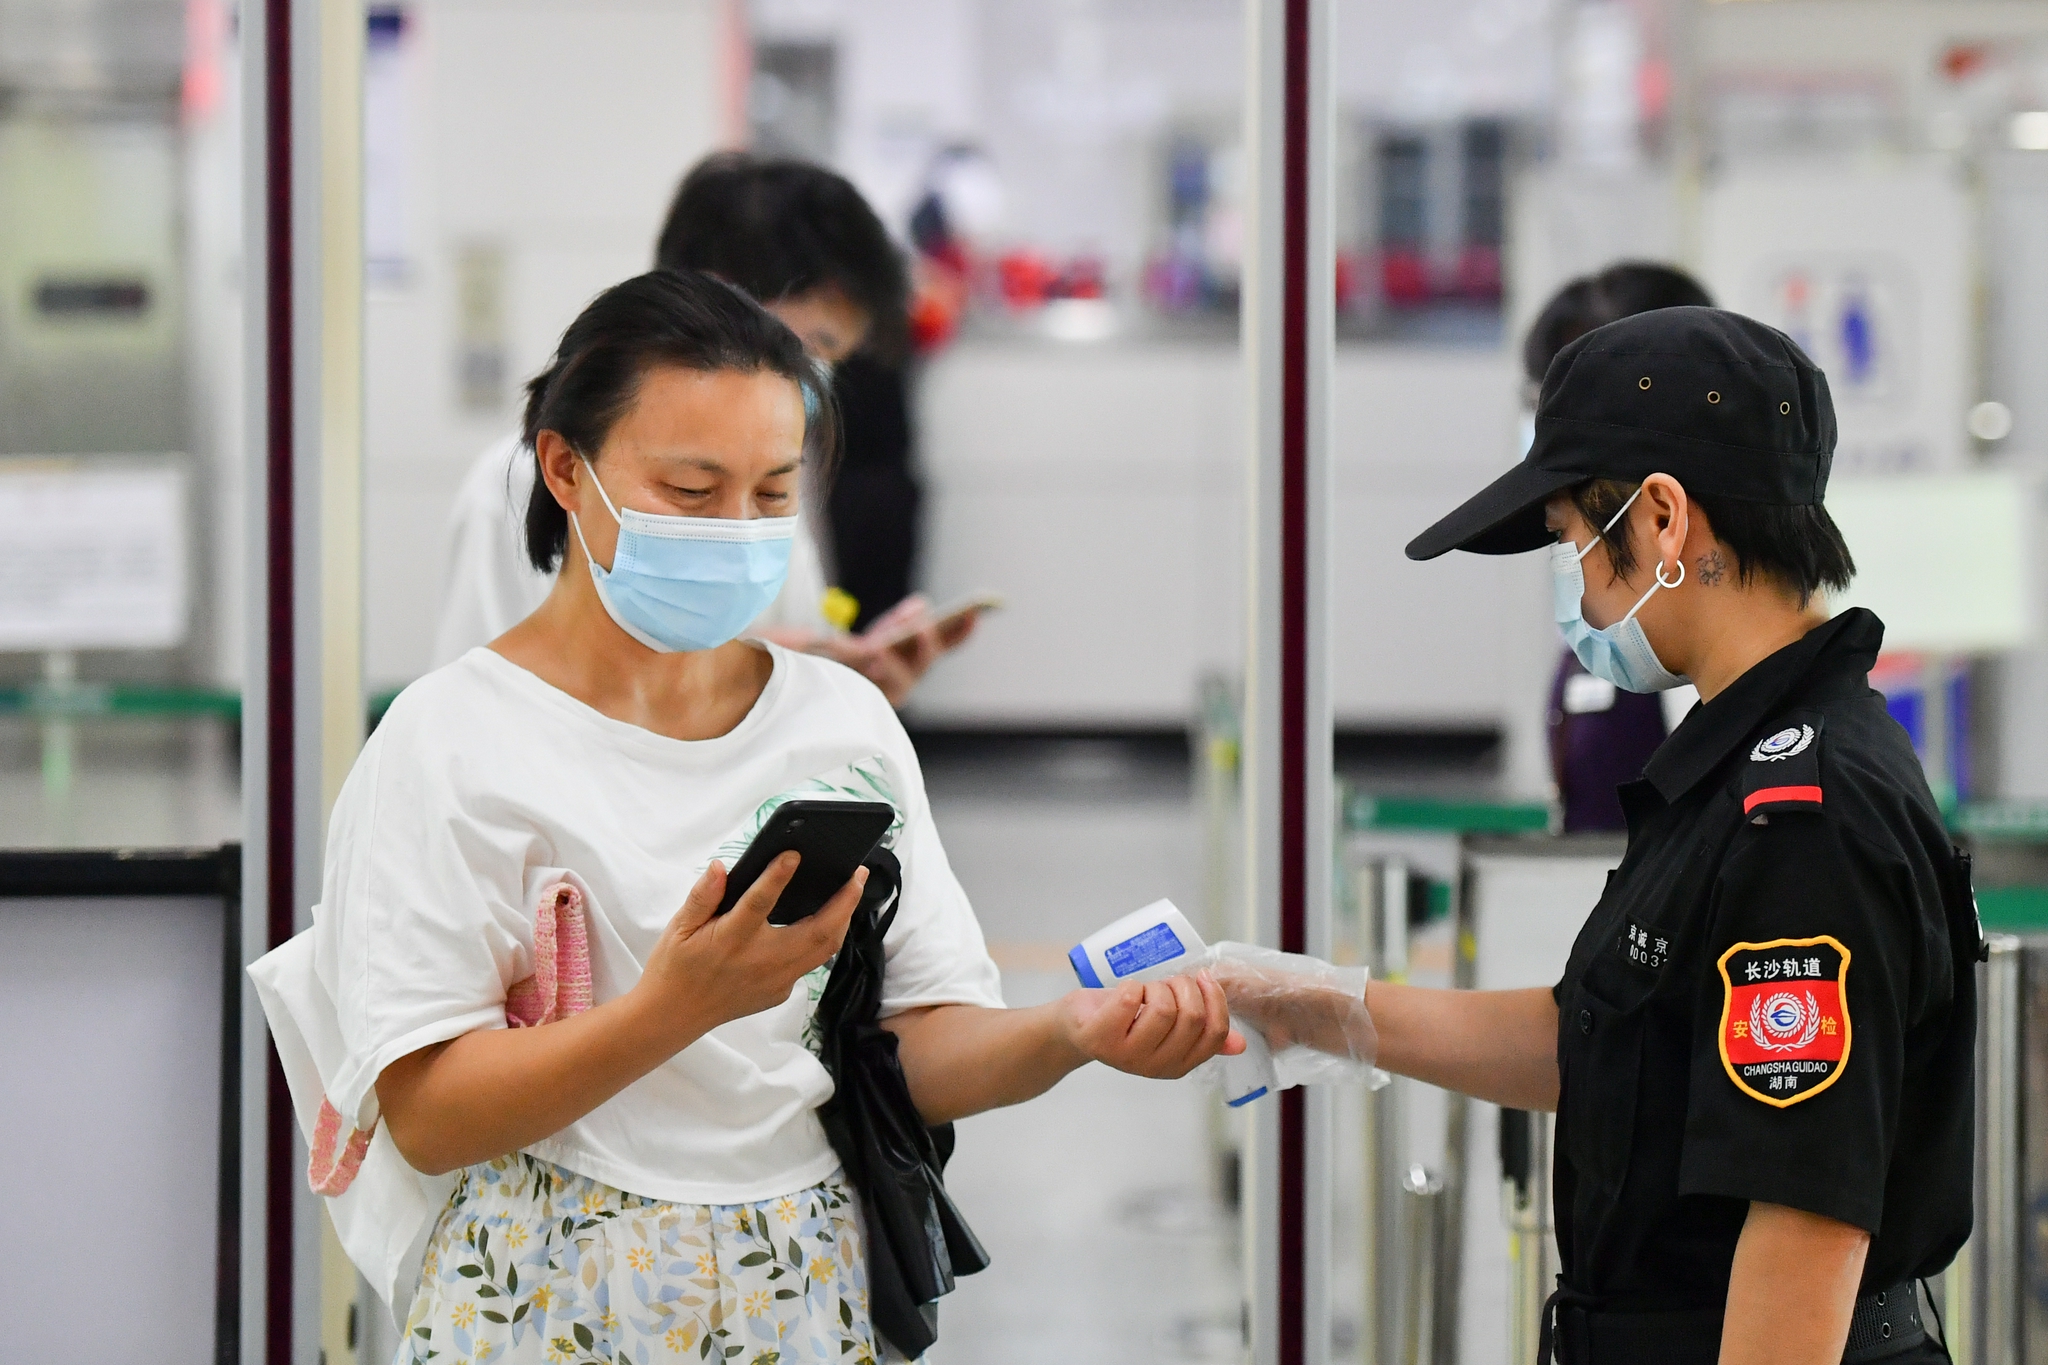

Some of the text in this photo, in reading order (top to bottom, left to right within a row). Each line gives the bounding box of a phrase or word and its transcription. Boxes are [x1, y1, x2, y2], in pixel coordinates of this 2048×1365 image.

[1745, 957, 1821, 981] 长沙轨道
[1733, 1016, 1837, 1038] 安 检
[1769, 1075, 1798, 1090] 湖南
